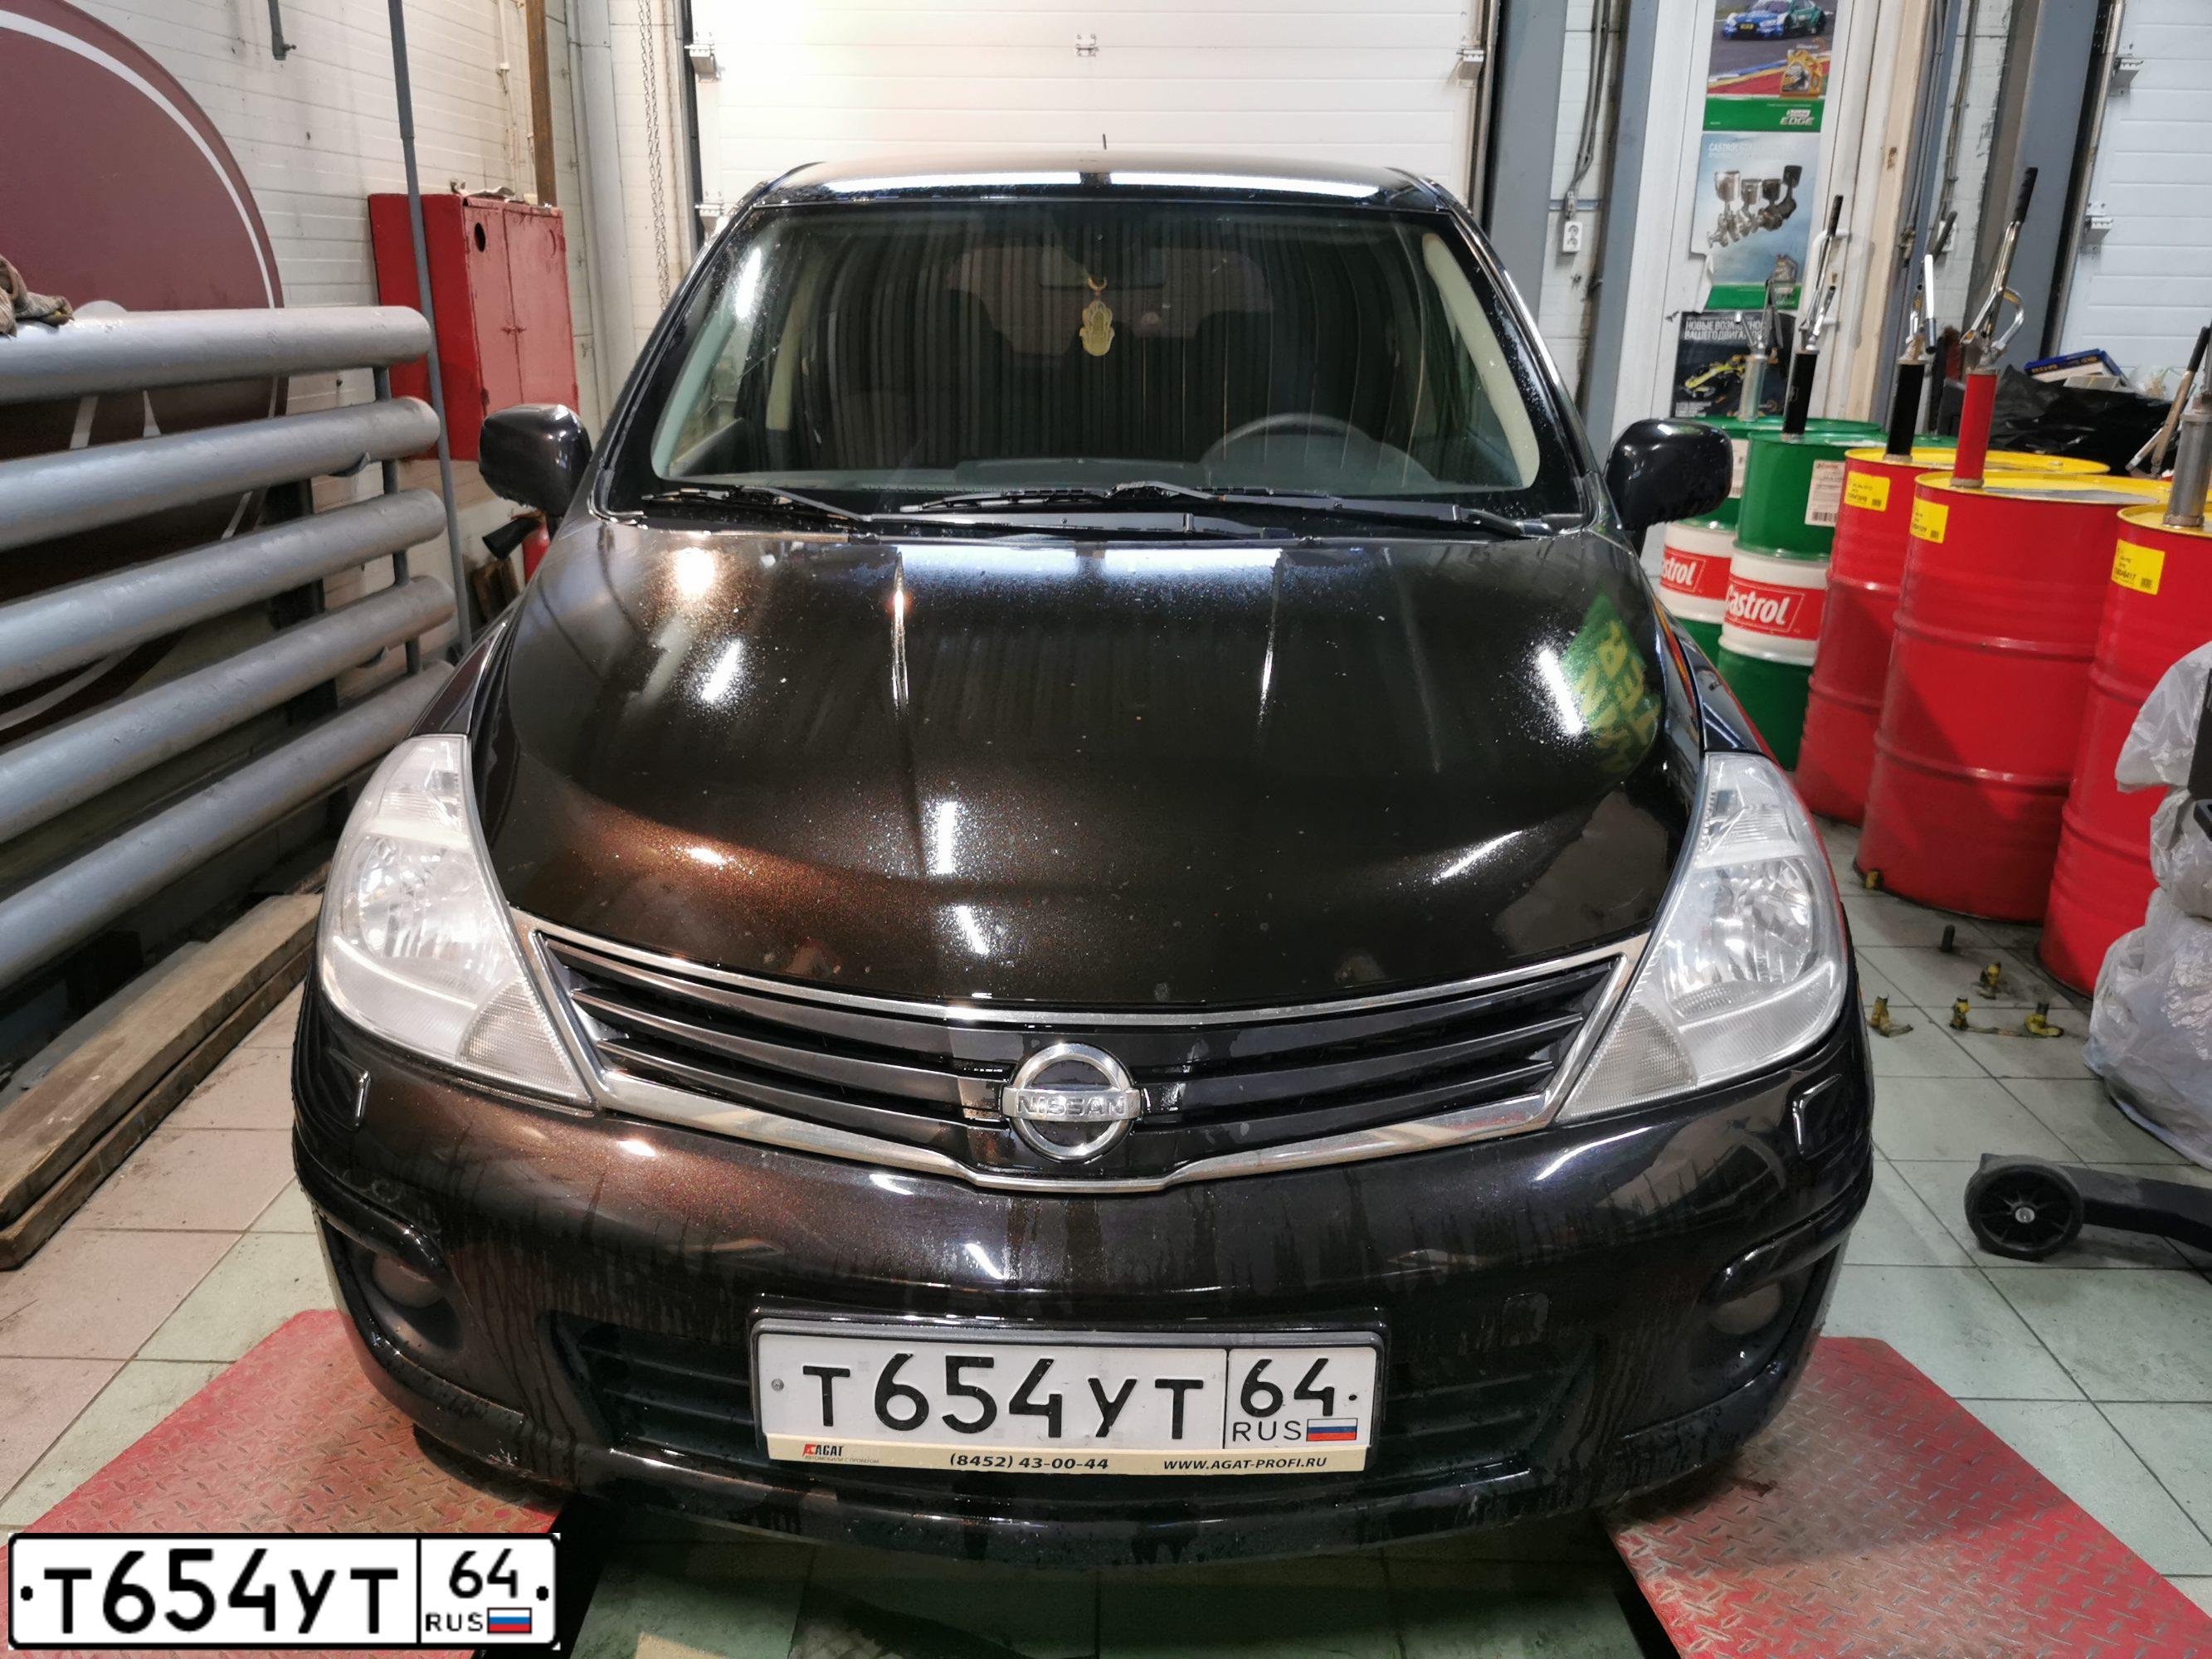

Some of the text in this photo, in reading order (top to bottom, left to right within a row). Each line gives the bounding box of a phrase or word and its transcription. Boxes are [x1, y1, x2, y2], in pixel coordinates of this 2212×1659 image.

[1685, 320, 1713, 330] НОВЫЕ
[1726, 583, 1791, 625] Castrol
[1016, 1095, 1126, 1116] NISSAN
[1240, 1358, 1334, 1418] 64
[1232, 1419, 1302, 1442] RUS
[950, 1453, 1109, 1470] (8452) 43-00-44
[1163, 1457, 1328, 1470] WWW.AGAT-PROFI.RU
